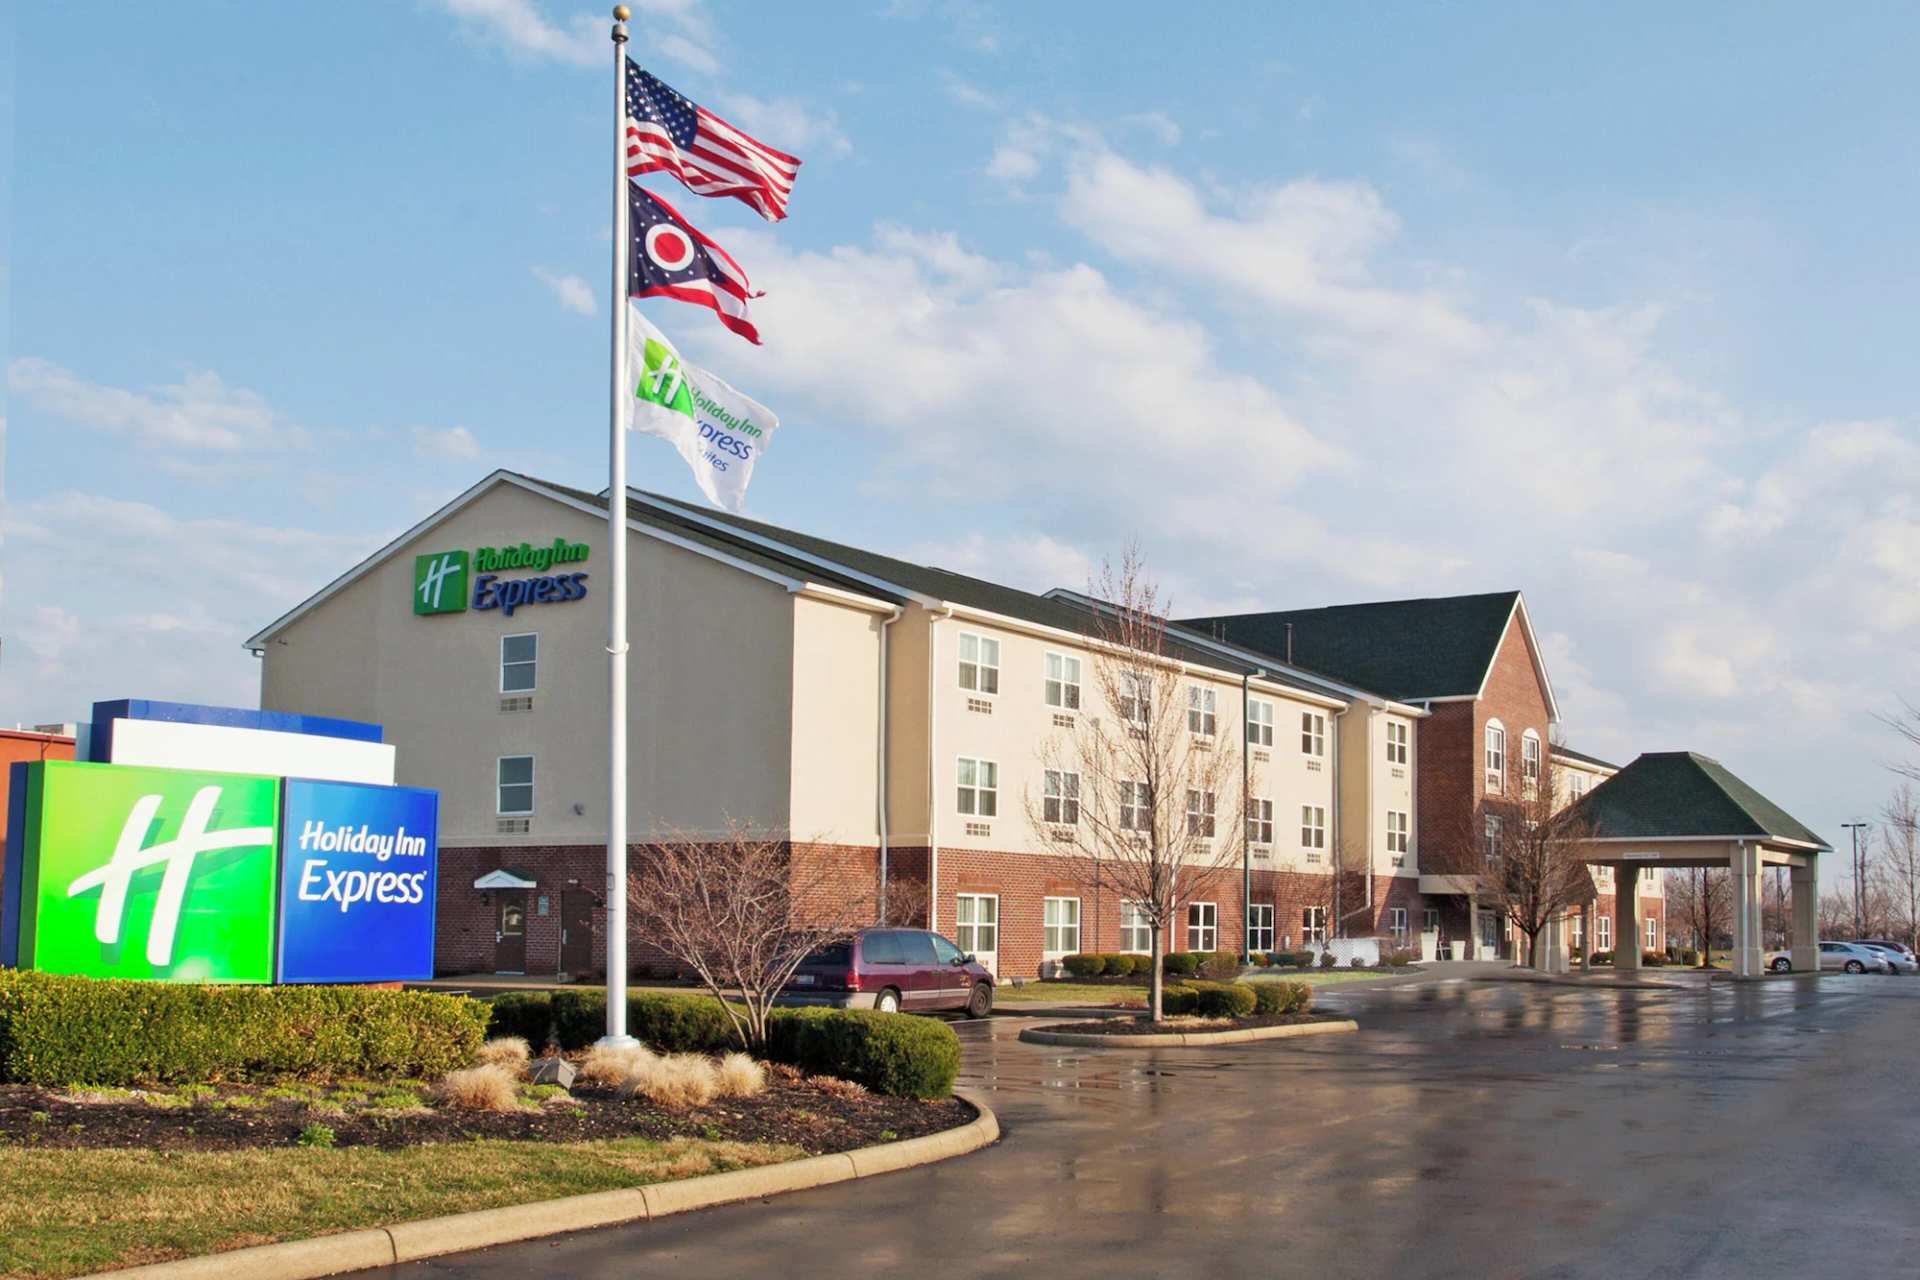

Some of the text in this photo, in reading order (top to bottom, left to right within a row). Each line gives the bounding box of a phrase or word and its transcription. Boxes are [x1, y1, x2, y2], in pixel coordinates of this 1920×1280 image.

[697, 420, 753, 460] press
[739, 418, 763, 439] Inn
[473, 537, 590, 572] Holiday Inn
[472, 572, 589, 617] Express
[299, 820, 426, 861] Holiday Inn
[299, 859, 427, 913] Express
